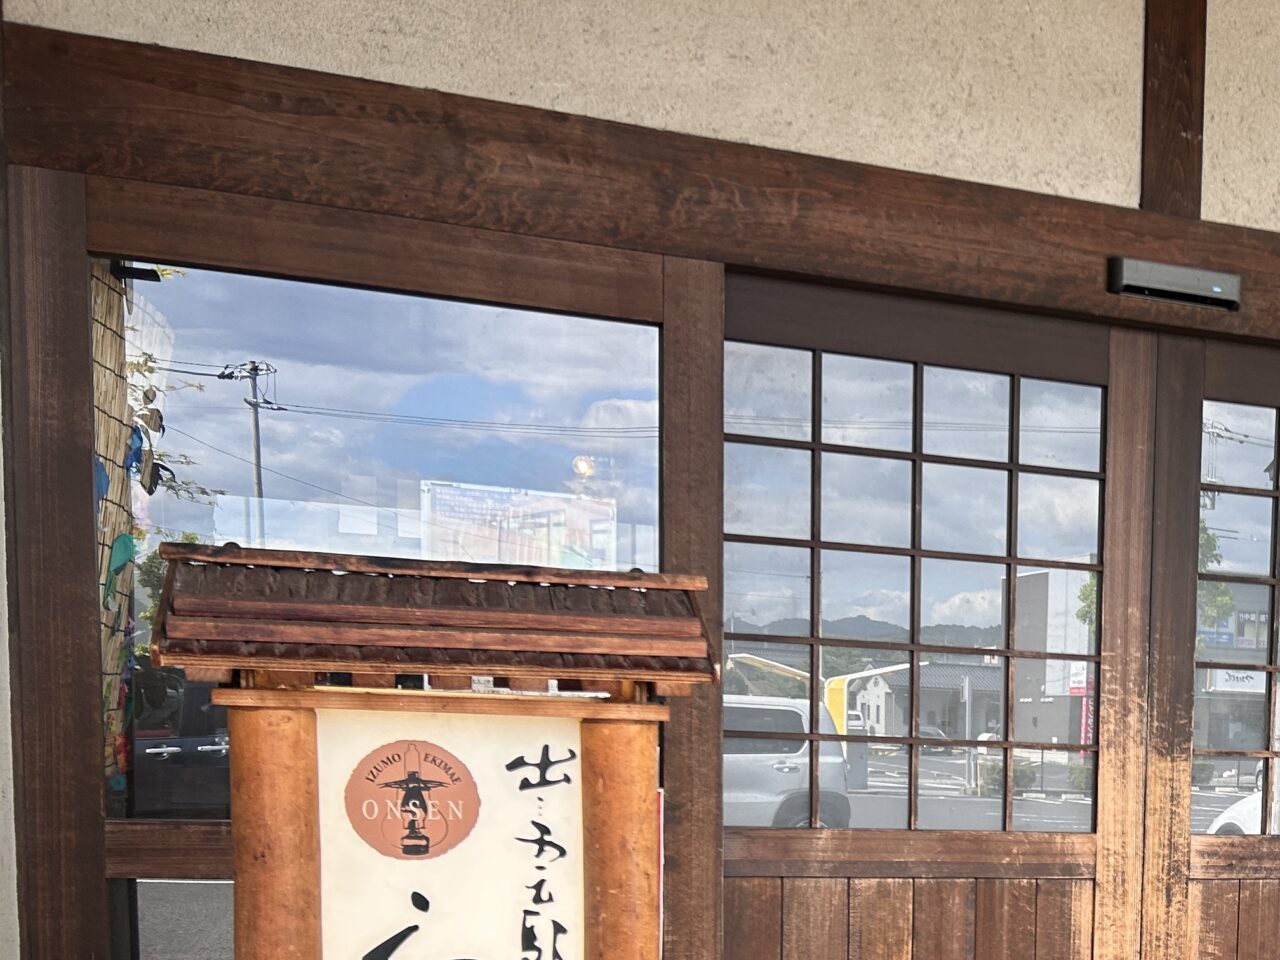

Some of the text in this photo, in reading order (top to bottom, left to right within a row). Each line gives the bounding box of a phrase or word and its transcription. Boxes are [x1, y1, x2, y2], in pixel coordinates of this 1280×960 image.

[365, 752, 462, 786] IZUMO EKIMAE
[361, 798, 465, 821] ONSEN
